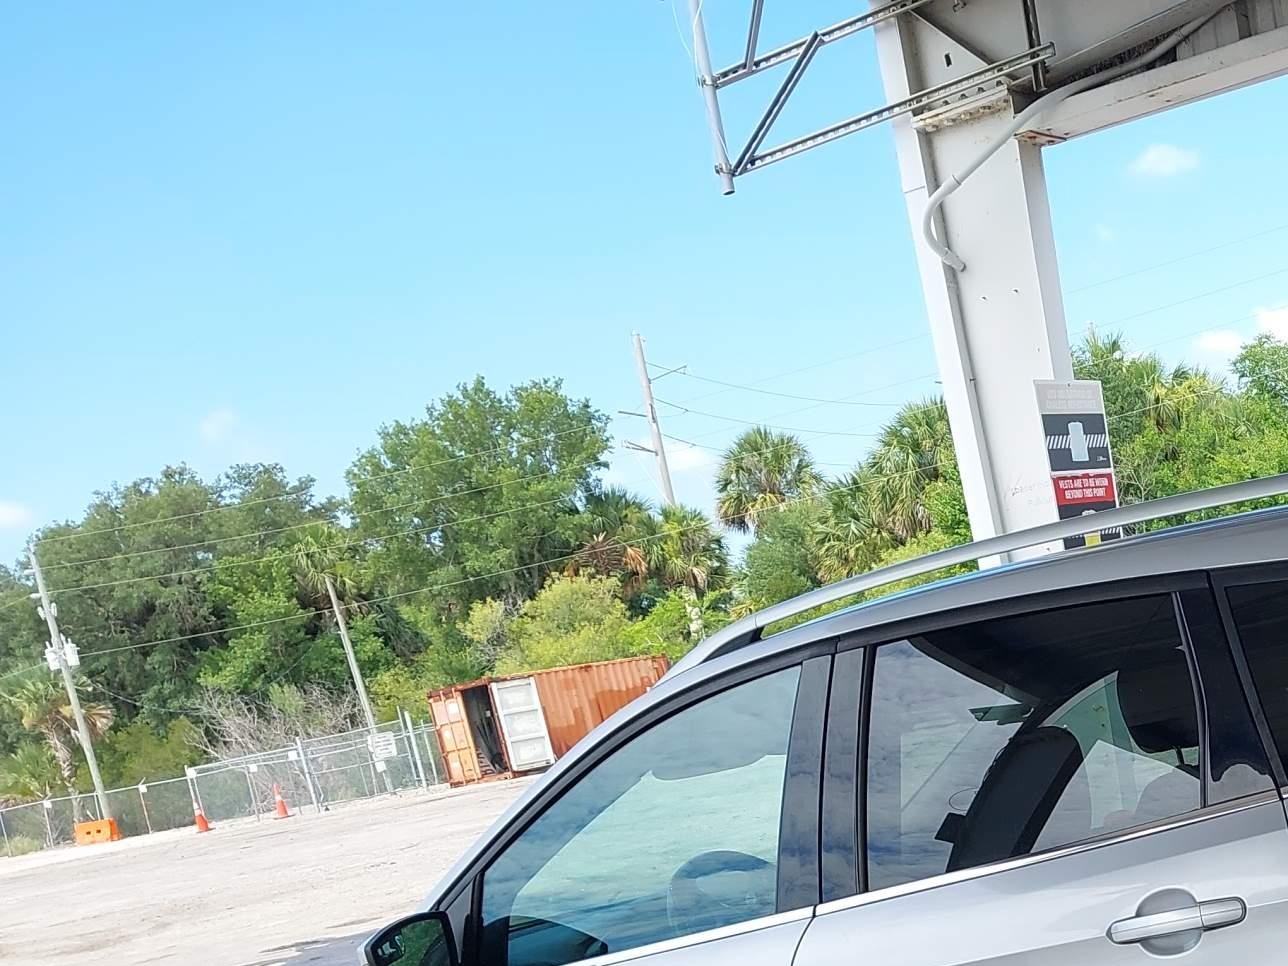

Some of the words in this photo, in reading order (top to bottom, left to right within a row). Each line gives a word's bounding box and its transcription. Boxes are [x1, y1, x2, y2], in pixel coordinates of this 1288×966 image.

[1058, 479, 1074, 489] VESTS
[1083, 488, 1093, 498] THIS
[1093, 487, 1106, 497] POINT
